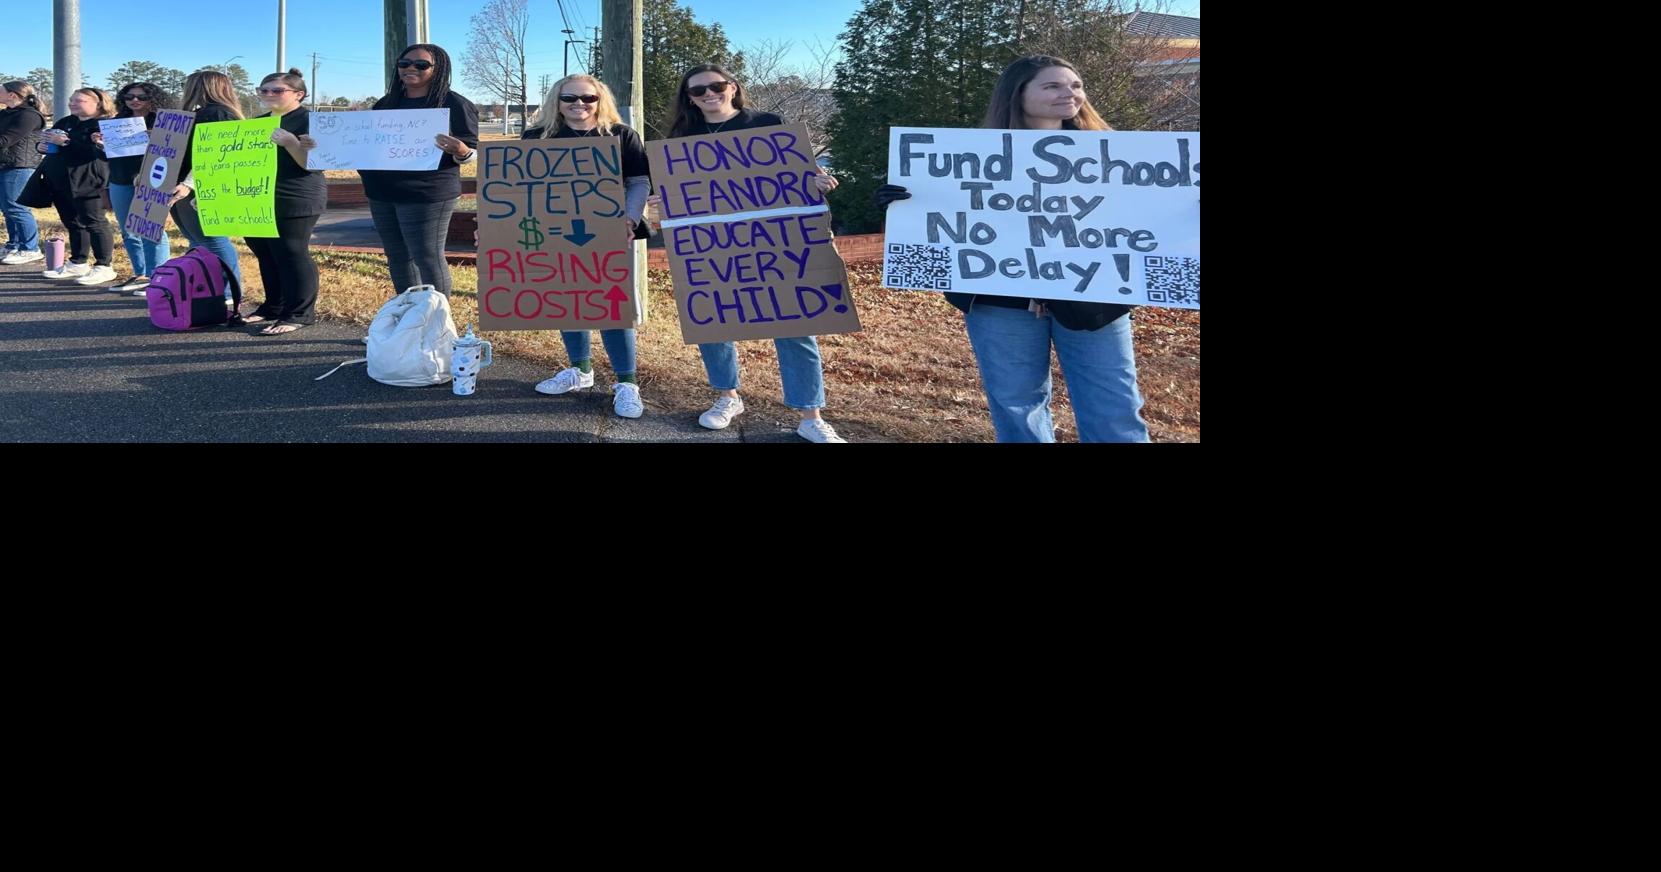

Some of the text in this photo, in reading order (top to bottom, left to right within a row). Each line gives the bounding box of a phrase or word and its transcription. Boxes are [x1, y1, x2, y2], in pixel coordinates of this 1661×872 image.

[155, 111, 193, 135] SUPPORT
[199, 125, 266, 141] We need more
[149, 144, 177, 159] TEACHERS
[165, 133, 172, 146] 4
[197, 137, 274, 162] than gold stars
[375, 133, 406, 145] RAISE
[388, 146, 436, 159] SCORES!
[663, 132, 810, 175] HONOR
[194, 154, 268, 176] and jeans passes!
[485, 144, 620, 180] FROZEN
[899, 132, 1013, 182] Fund
[137, 185, 173, 207] SUPPORT
[195, 176, 270, 200] Pass the budget!
[482, 178, 625, 219] STEPS,
[660, 170, 825, 219] LEANDRO
[960, 181, 1105, 221] Today
[144, 203, 152, 217] 4
[200, 206, 273, 226] Fund our schools!
[126, 213, 164, 242] STUDENTS
[517, 216, 545, 250] $
[673, 213, 831, 256] EDUCATE
[926, 211, 1158, 252] No More
[486, 248, 629, 284] RISING
[685, 247, 810, 287] EVERY
[485, 286, 609, 321] COSTS
[687, 282, 849, 325] CHILD!
